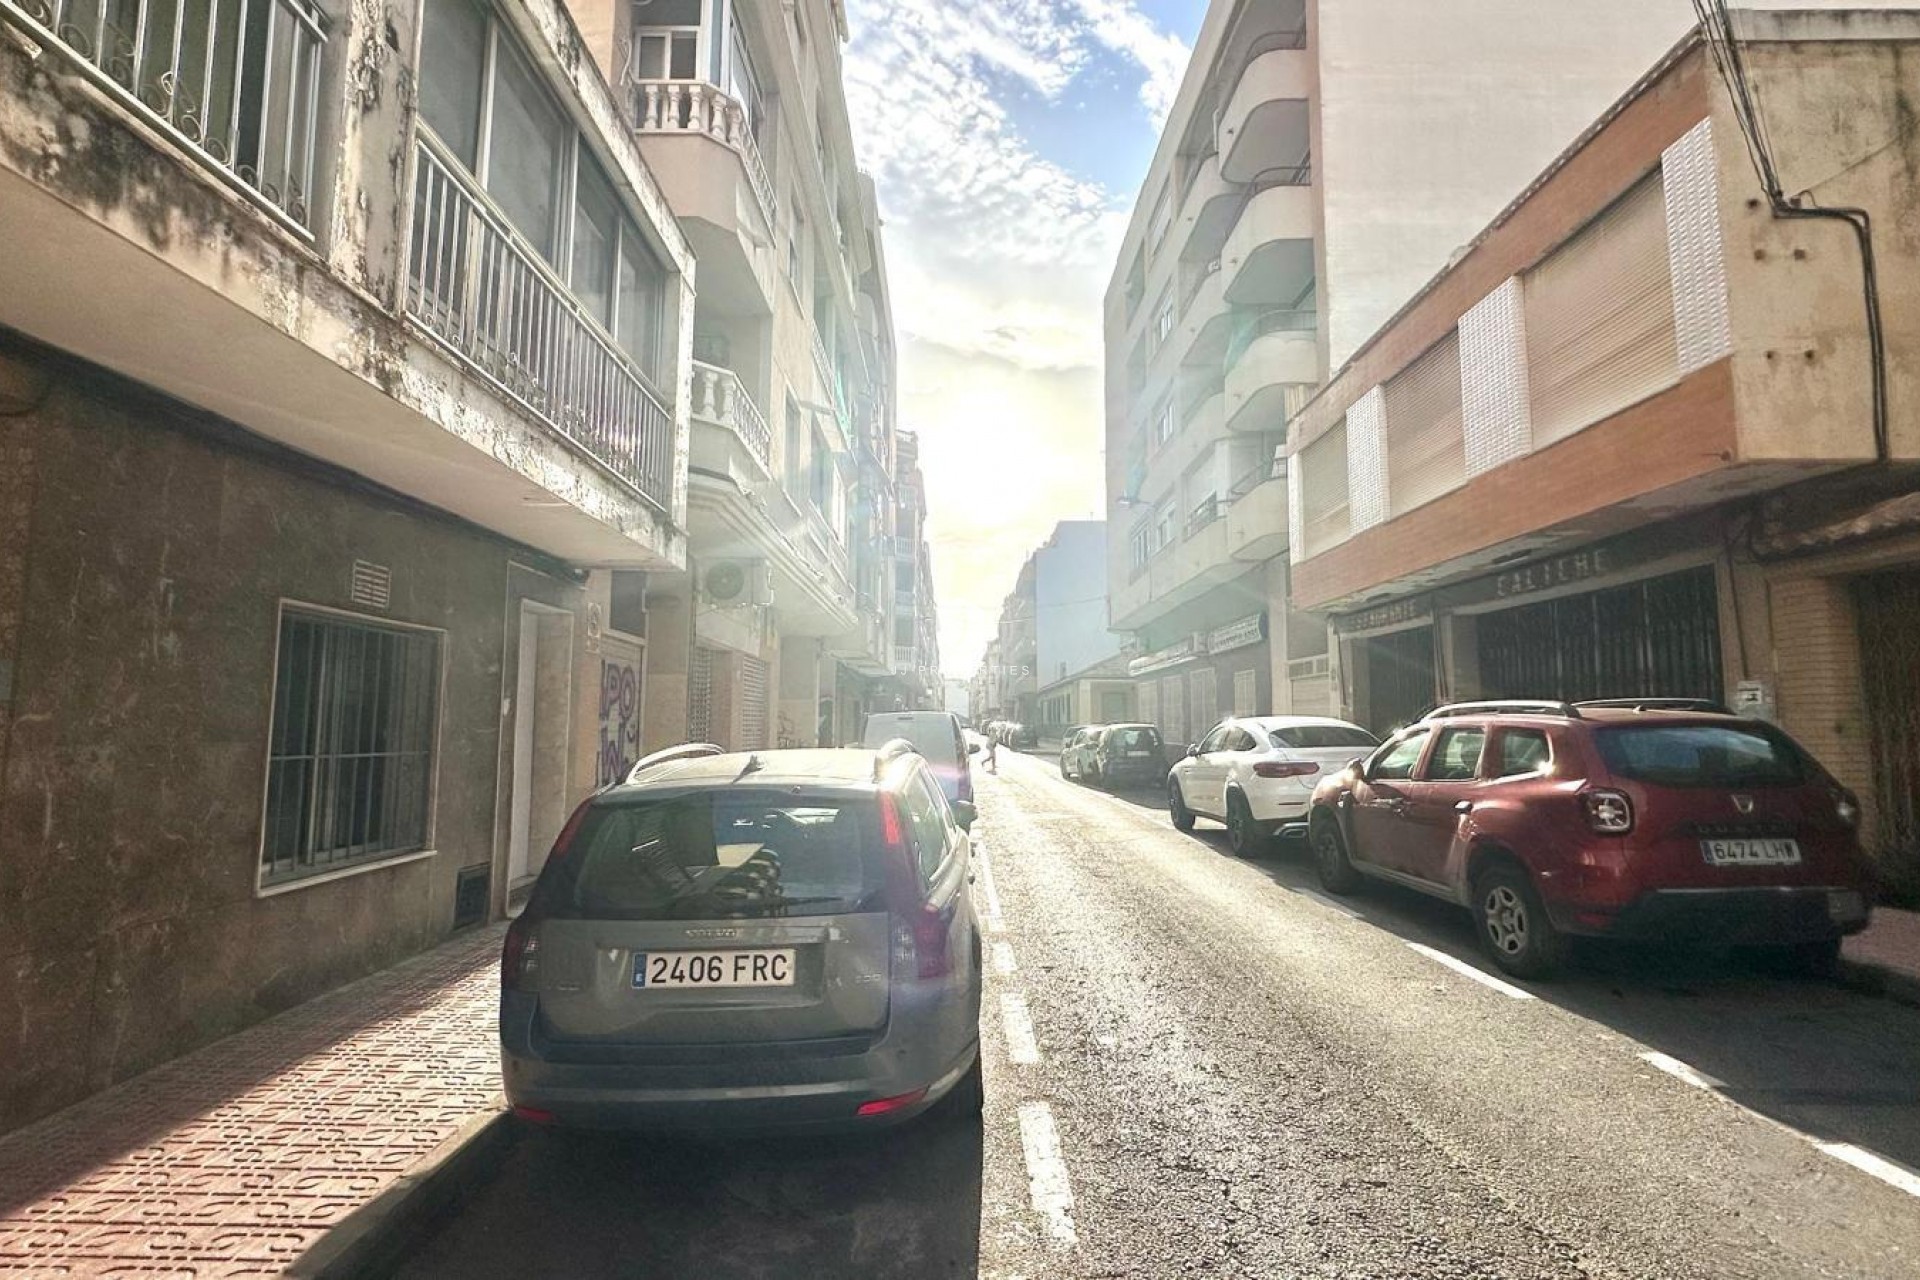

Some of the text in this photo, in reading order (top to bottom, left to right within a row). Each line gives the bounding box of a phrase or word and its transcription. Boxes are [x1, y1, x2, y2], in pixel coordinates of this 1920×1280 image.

[1713, 841, 1758, 860] 6474
[651, 955, 723, 984] 2406
[732, 953, 788, 982] FRC
